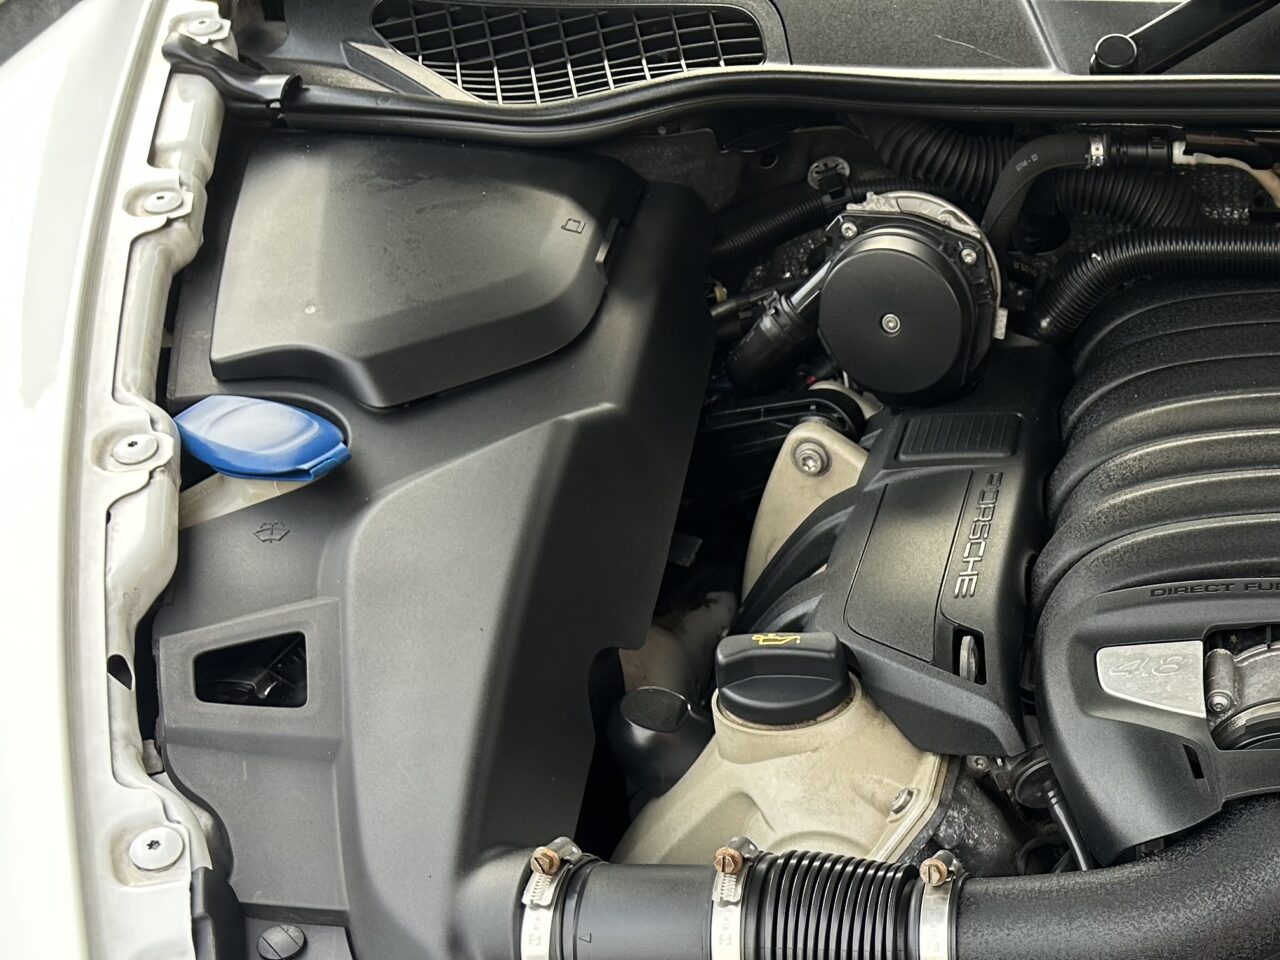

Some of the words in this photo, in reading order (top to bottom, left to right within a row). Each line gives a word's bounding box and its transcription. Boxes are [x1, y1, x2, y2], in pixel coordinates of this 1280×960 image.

[952, 471, 1004, 599] PORSCHE
[1150, 582, 1234, 598] DIRECT
[1108, 655, 1184, 677] 4.8
